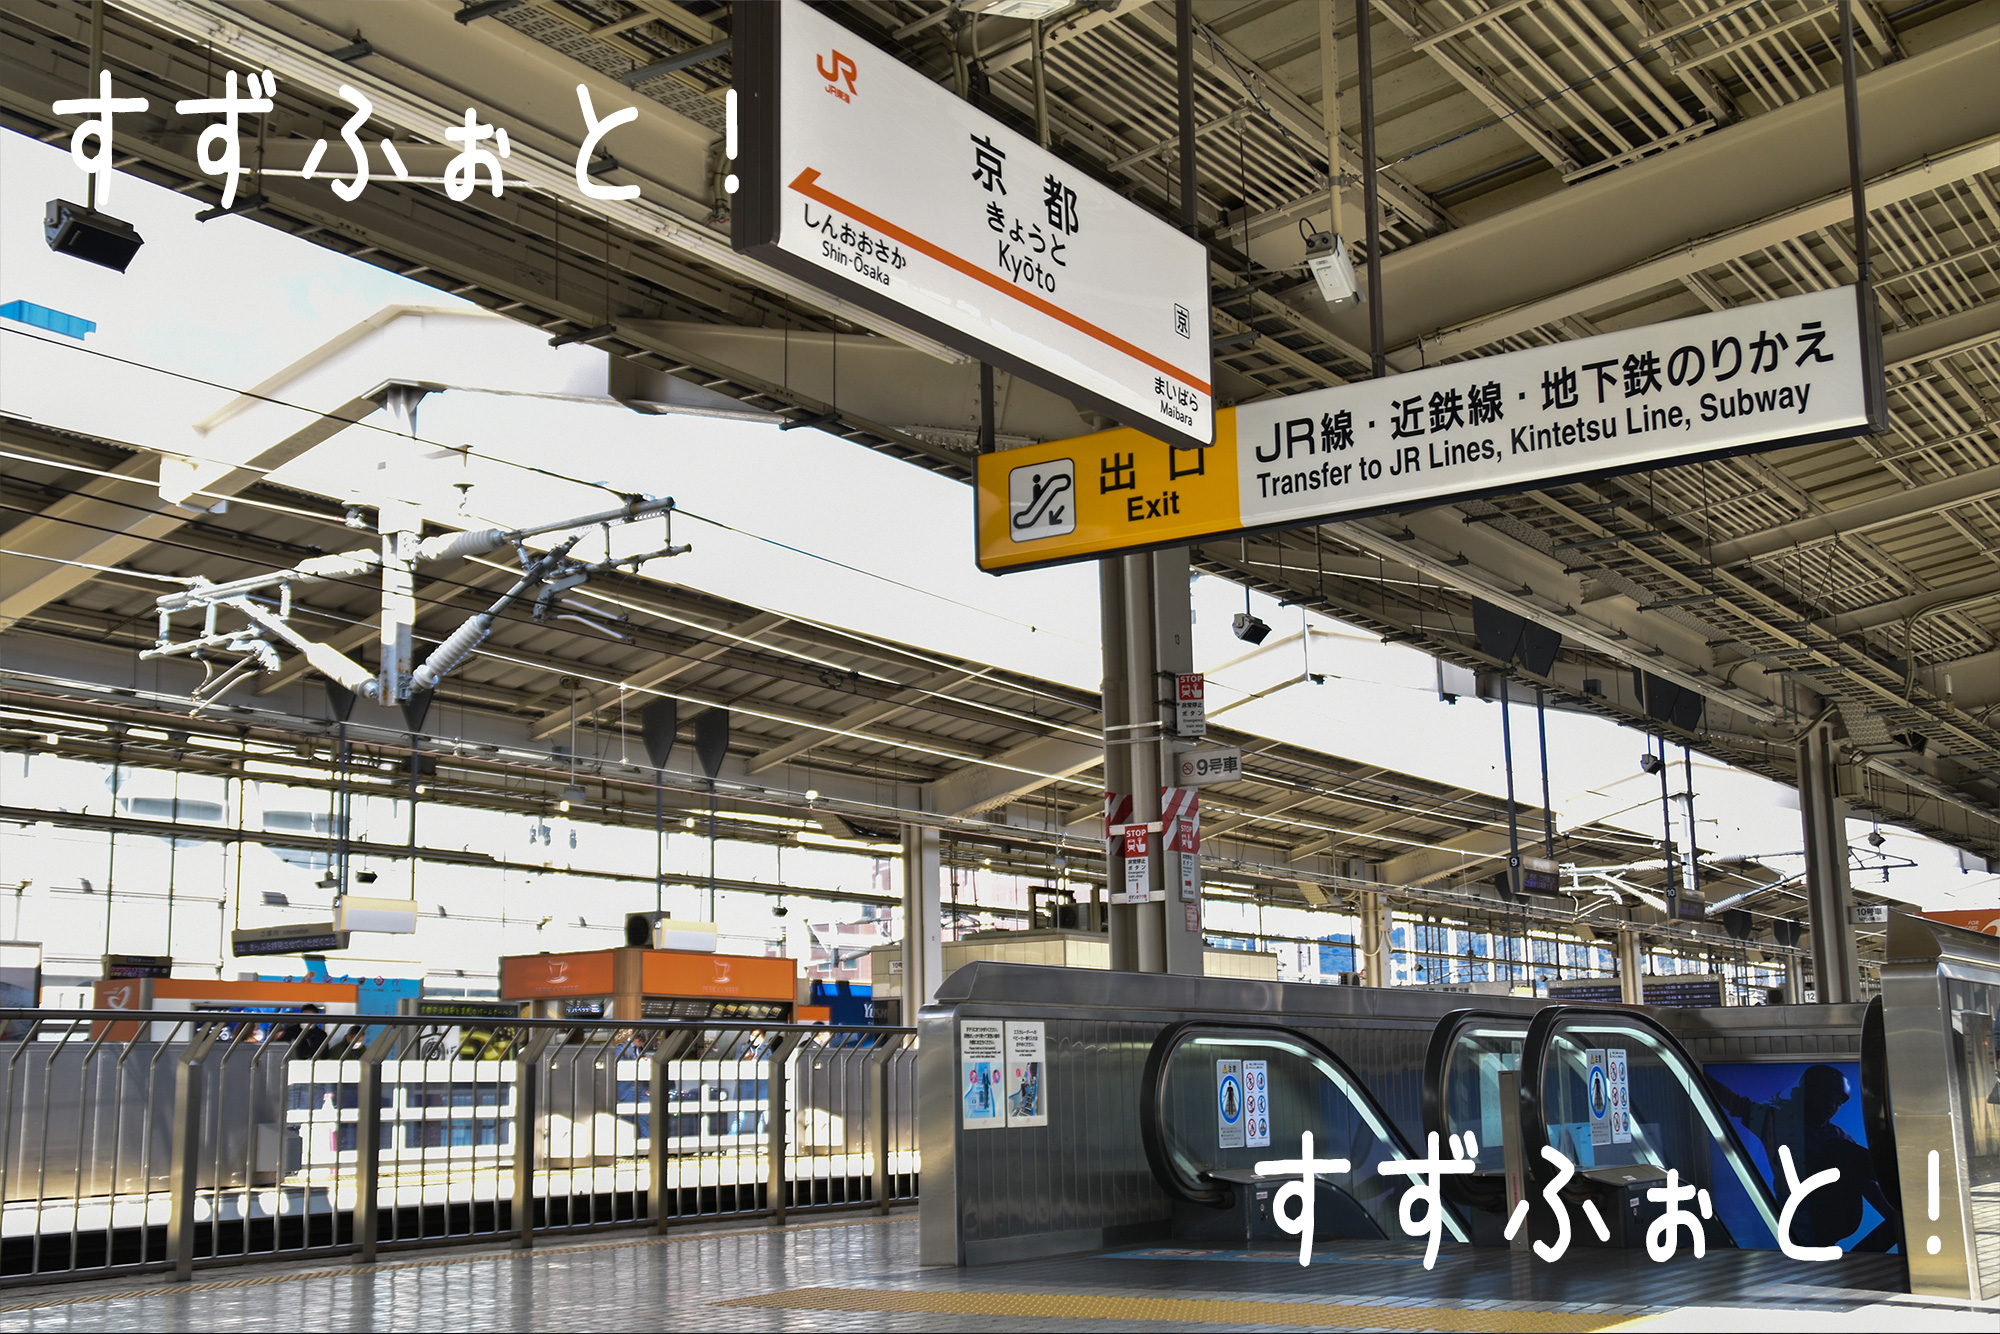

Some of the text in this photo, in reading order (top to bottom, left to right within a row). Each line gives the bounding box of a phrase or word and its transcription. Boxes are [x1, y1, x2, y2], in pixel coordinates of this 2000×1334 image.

[816, 49, 858, 96] JR
[969, 133, 1079, 237] 京都
[803, 202, 907, 270] しんおおさか
[986, 201, 1067, 268] きょうと
[821, 240, 890, 287] Shin-Ōsaka
[998, 239, 1056, 294] Kyōto
[1177, 308, 1188, 334] 京
[1153, 376, 1199, 413] まいばら
[1159, 400, 1193, 427] Maibara
[1257, 382, 1811, 498] Transfer to JR Lines, Kintetsu Line, Subway
[1127, 491, 1180, 522] Exit
[1180, 675, 1203, 683] STOP
[1196, 756, 1238, 776] 9号車
[1126, 829, 1147, 838] STOP
[1180, 824, 1193, 832] STOP
[1511, 857, 1518, 867] 9
[1666, 888, 1676, 897] 10
[717, 986, 739, 994] COFFEE
